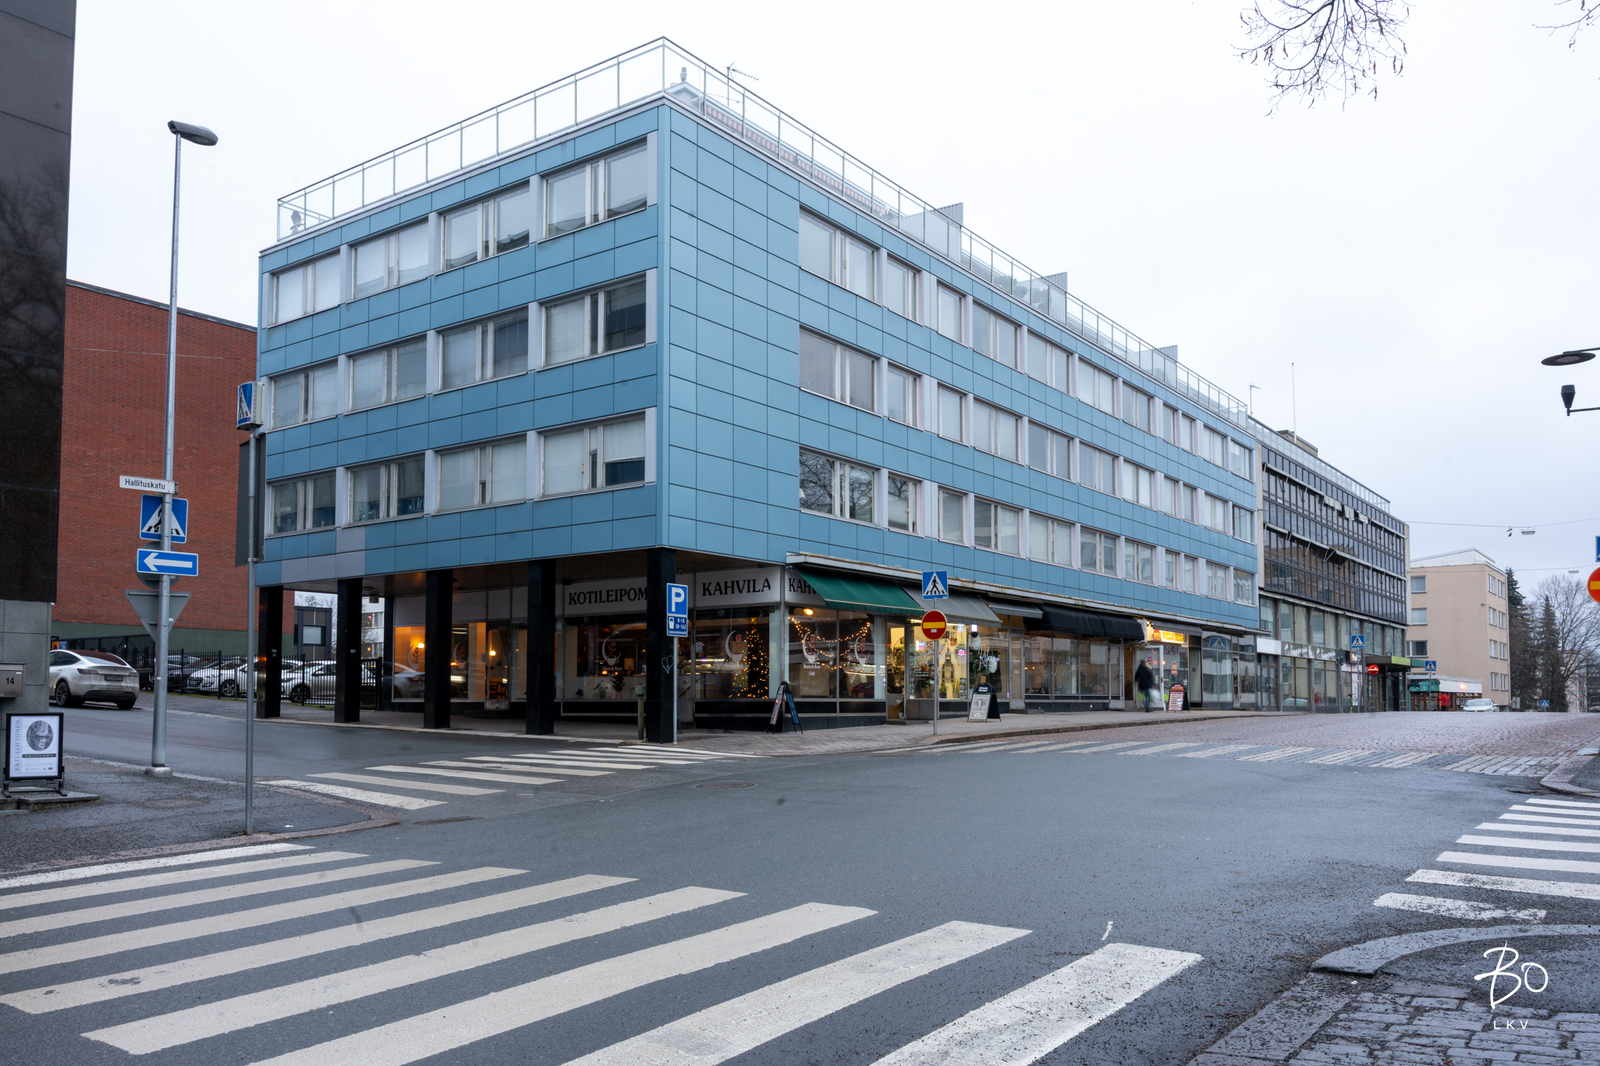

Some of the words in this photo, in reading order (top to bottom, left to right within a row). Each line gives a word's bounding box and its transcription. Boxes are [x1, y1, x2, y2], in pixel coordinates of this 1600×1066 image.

[124, 478, 166, 490] Hallituskatu
[702, 578, 772, 597] KAHVILA
[671, 586, 685, 612] P
[5, 677, 15, 685] 14
